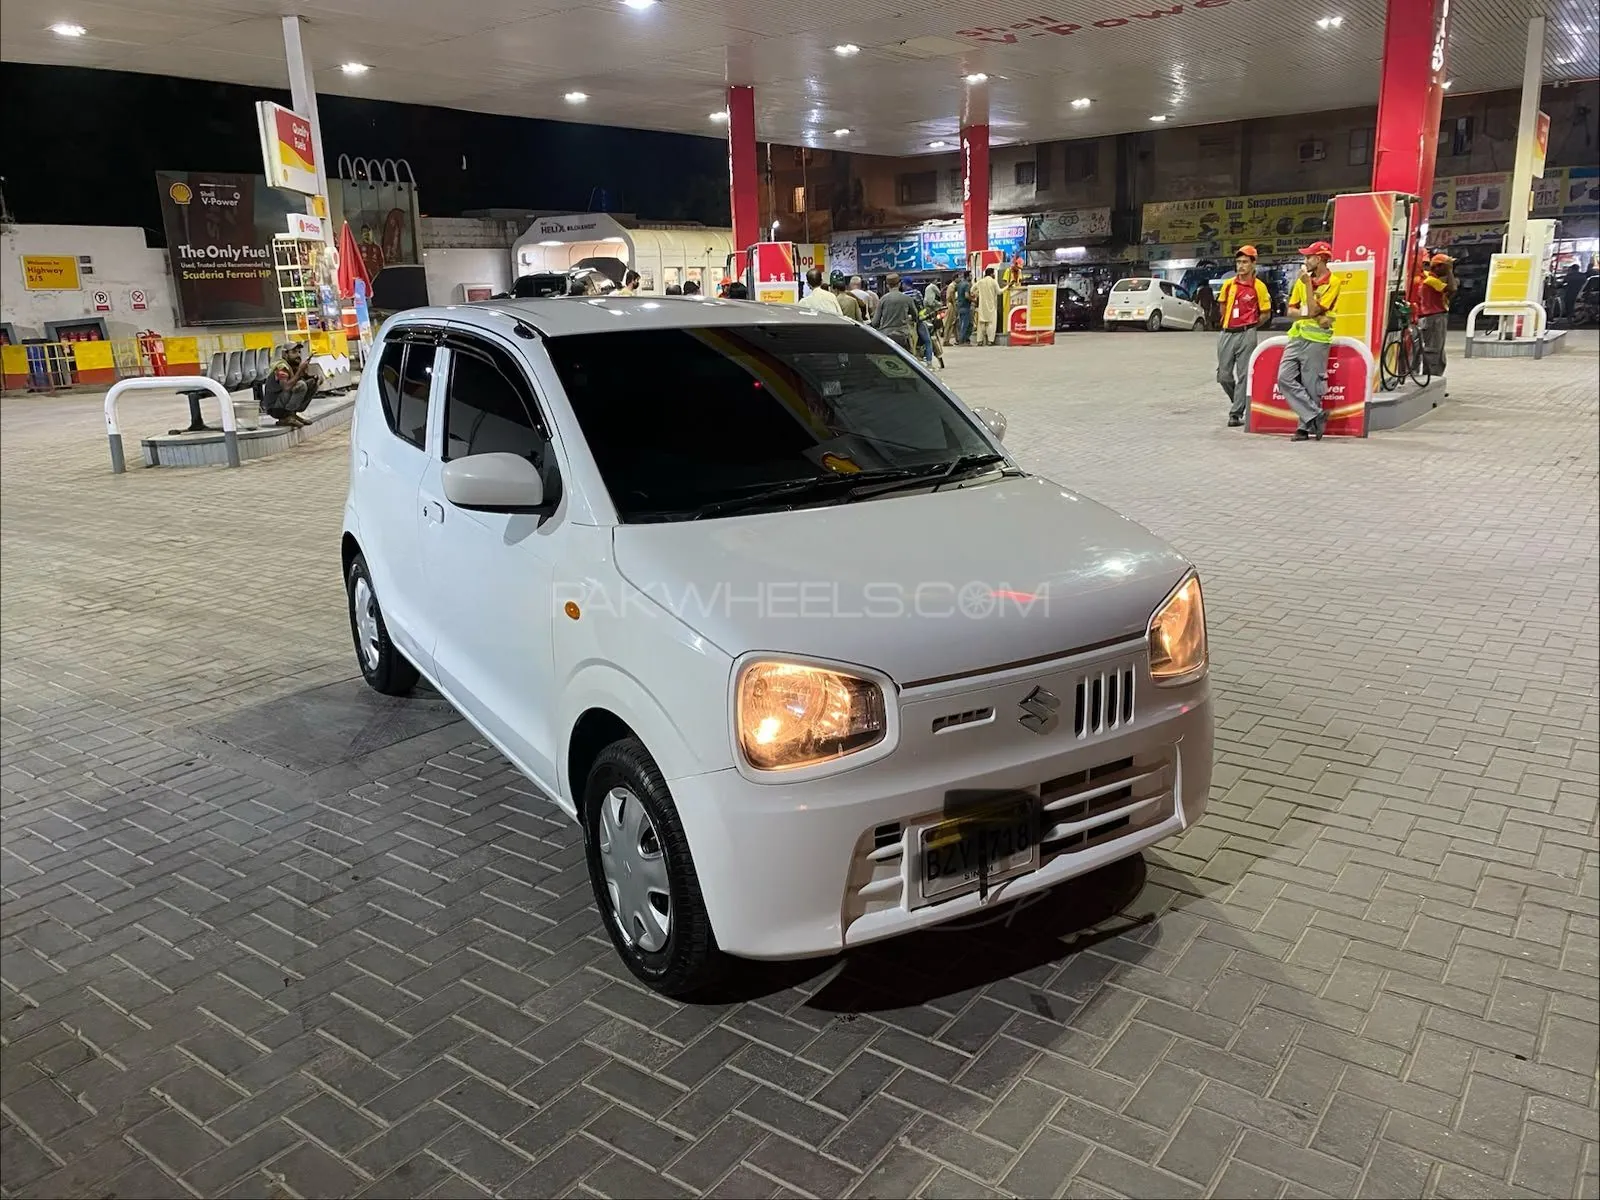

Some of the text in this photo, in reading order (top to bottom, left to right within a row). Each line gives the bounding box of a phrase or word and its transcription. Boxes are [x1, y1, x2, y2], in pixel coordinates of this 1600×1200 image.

[977, 0, 1240, 44] V-Powe
[201, 197, 238, 206] V-Power
[1248, 196, 1304, 208] Suspension
[178, 244, 270, 261] The Only Fuel
[796, 256, 814, 268] hop
[27, 266, 64, 275] Highway
[183, 270, 271, 280] Scuderia Ferrari HP
